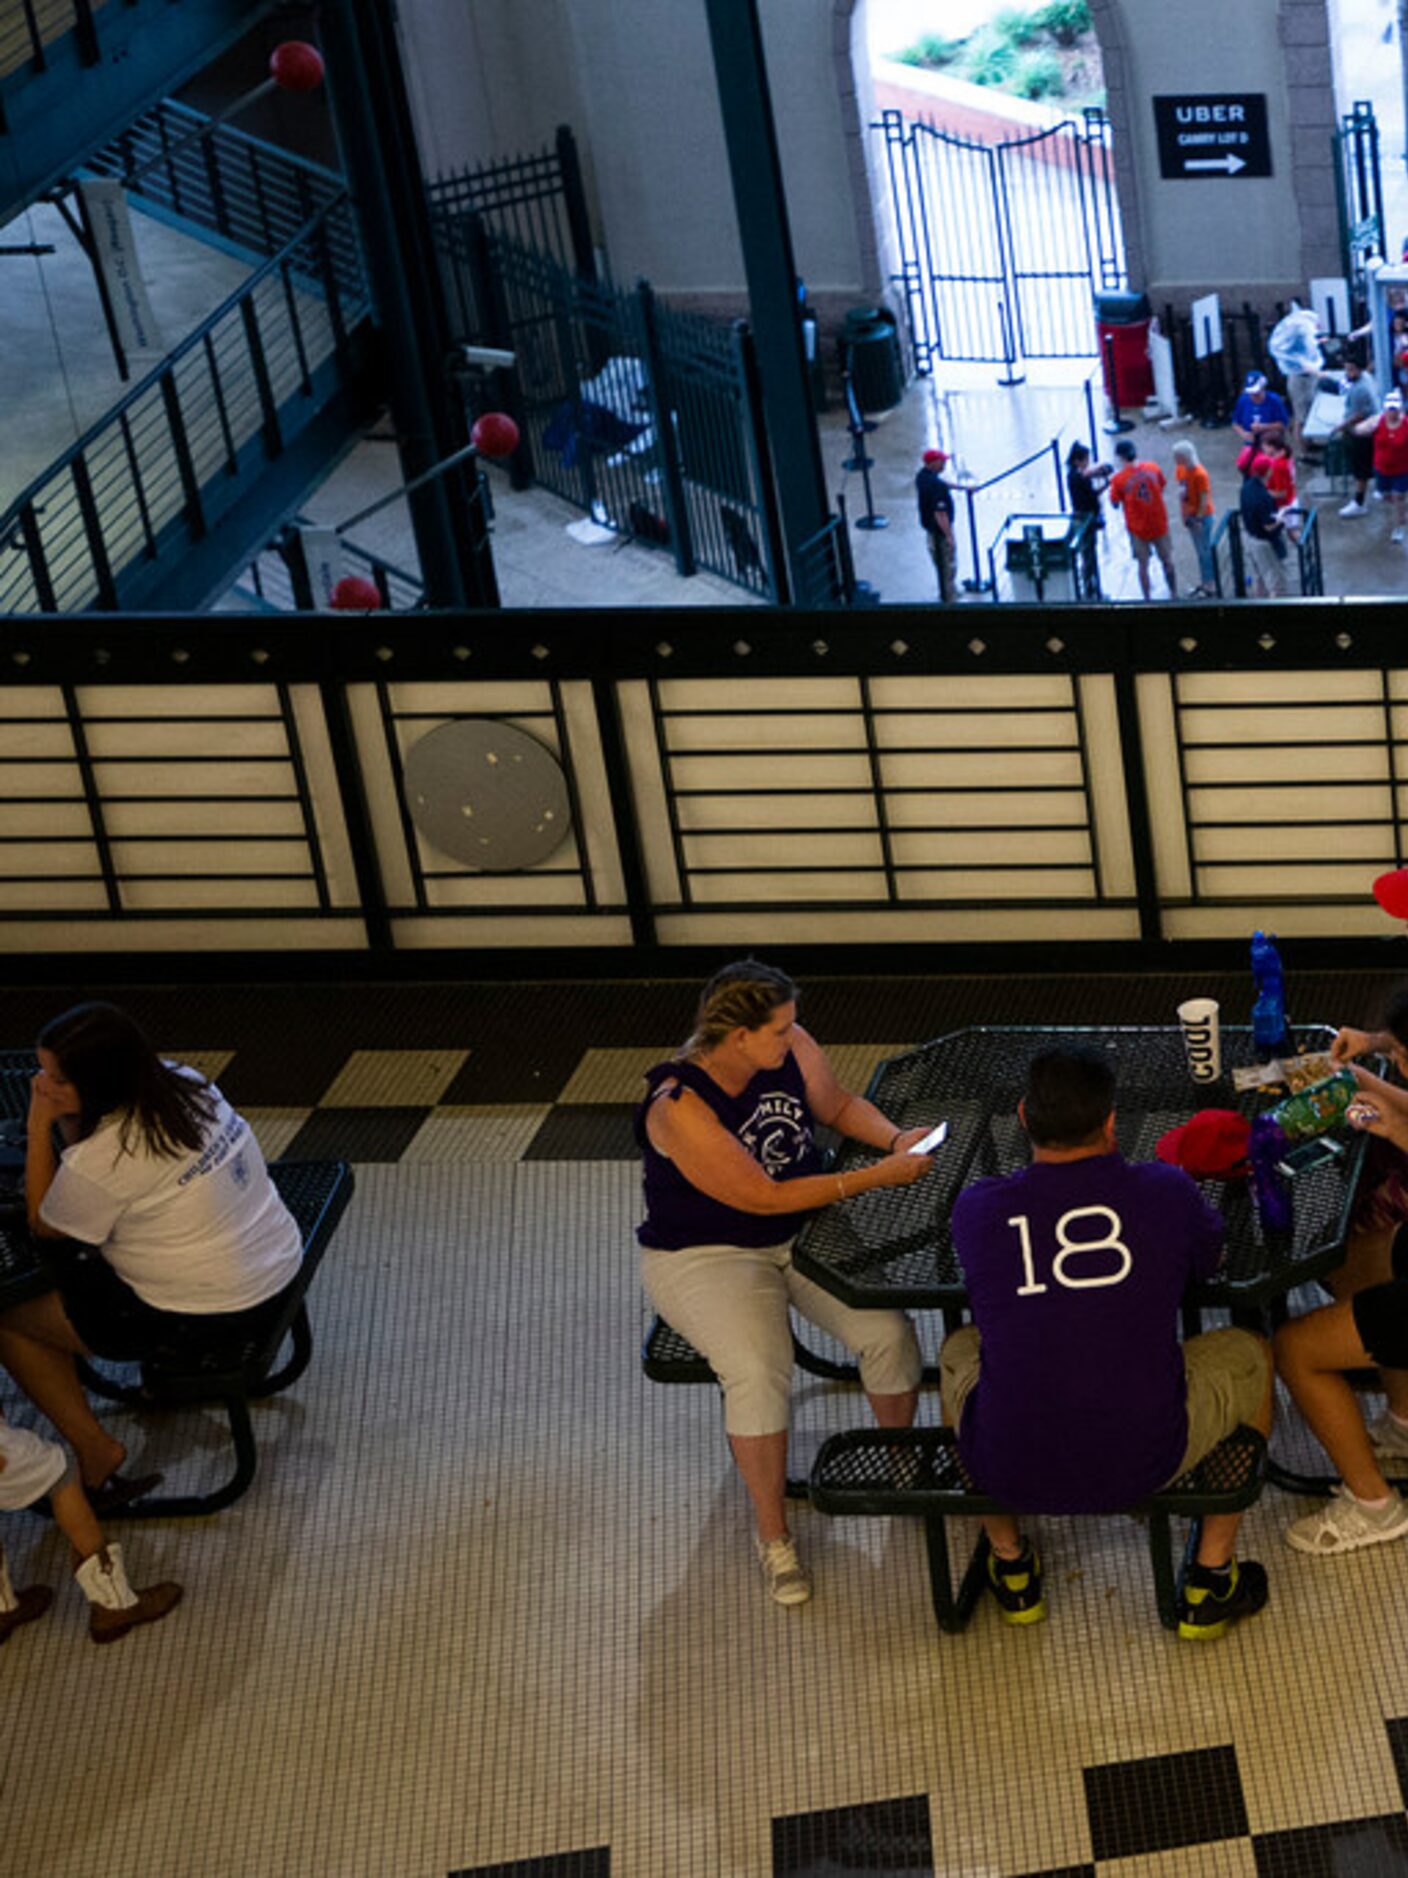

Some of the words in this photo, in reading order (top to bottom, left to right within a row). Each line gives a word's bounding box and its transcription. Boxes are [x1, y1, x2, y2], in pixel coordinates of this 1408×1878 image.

[1176, 104, 1245, 123] UBER
[1218, 132, 1237, 144] LOT
[1007, 1205, 1132, 1296] 18
